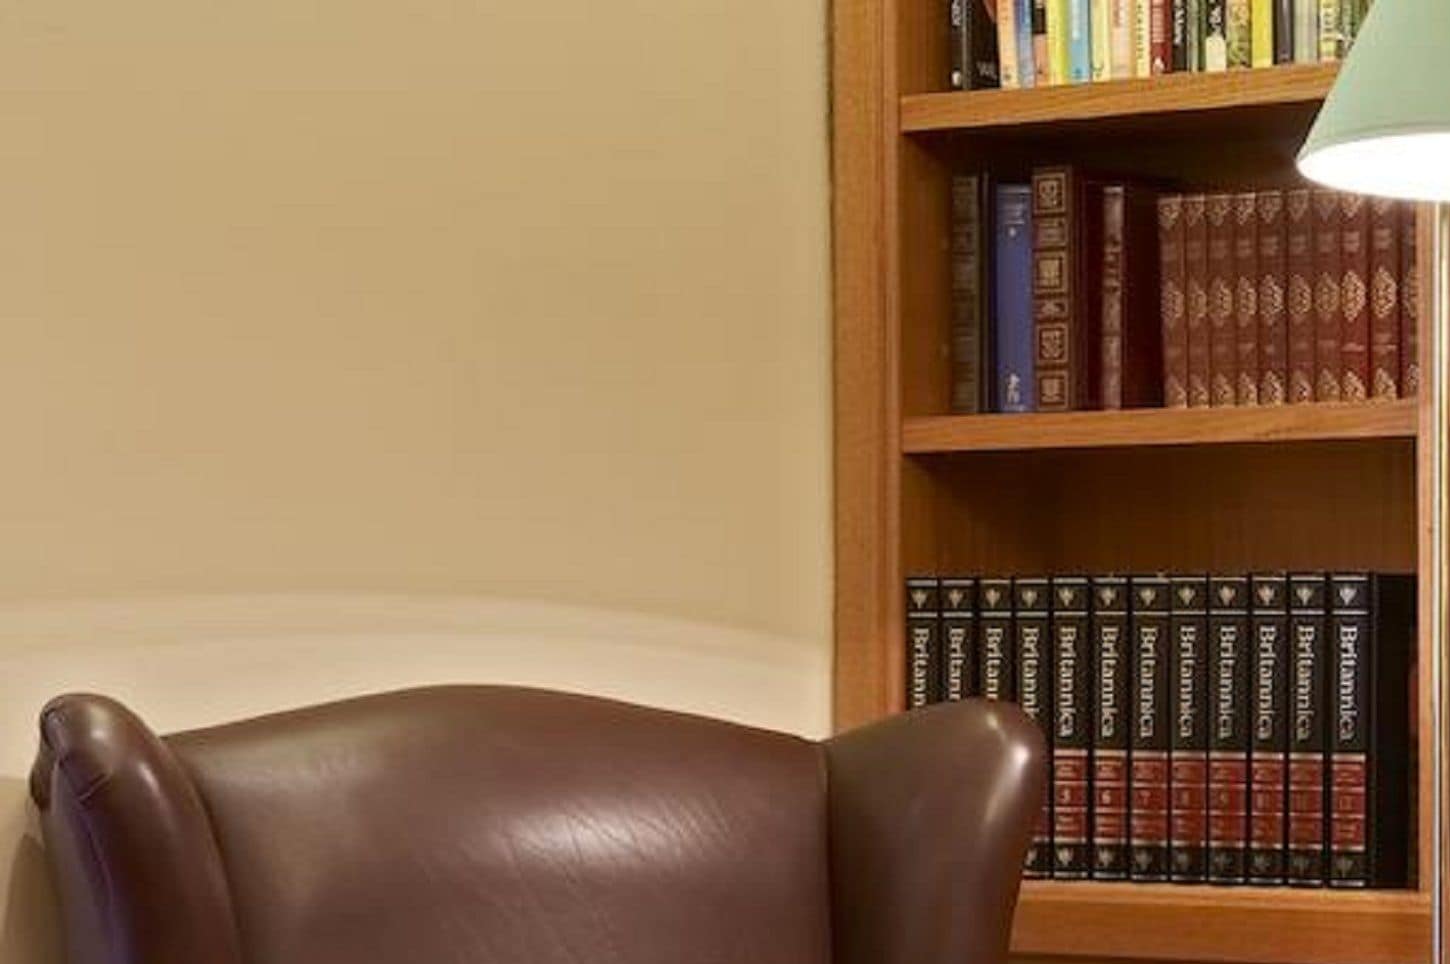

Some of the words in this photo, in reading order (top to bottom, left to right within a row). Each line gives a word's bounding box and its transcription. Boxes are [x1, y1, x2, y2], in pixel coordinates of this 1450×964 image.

[914, 628, 929, 707] Britann
[1060, 628, 1077, 737] Britannica
[1102, 628, 1119, 737] Britannica
[1140, 628, 1157, 738] Britannica
[1180, 627, 1196, 738] Britannica
[1219, 627, 1237, 739] Britannica
[1259, 626, 1276, 739] Britannica
[1297, 626, 1315, 740] Britannica
[1340, 627, 1358, 740] Britannica
